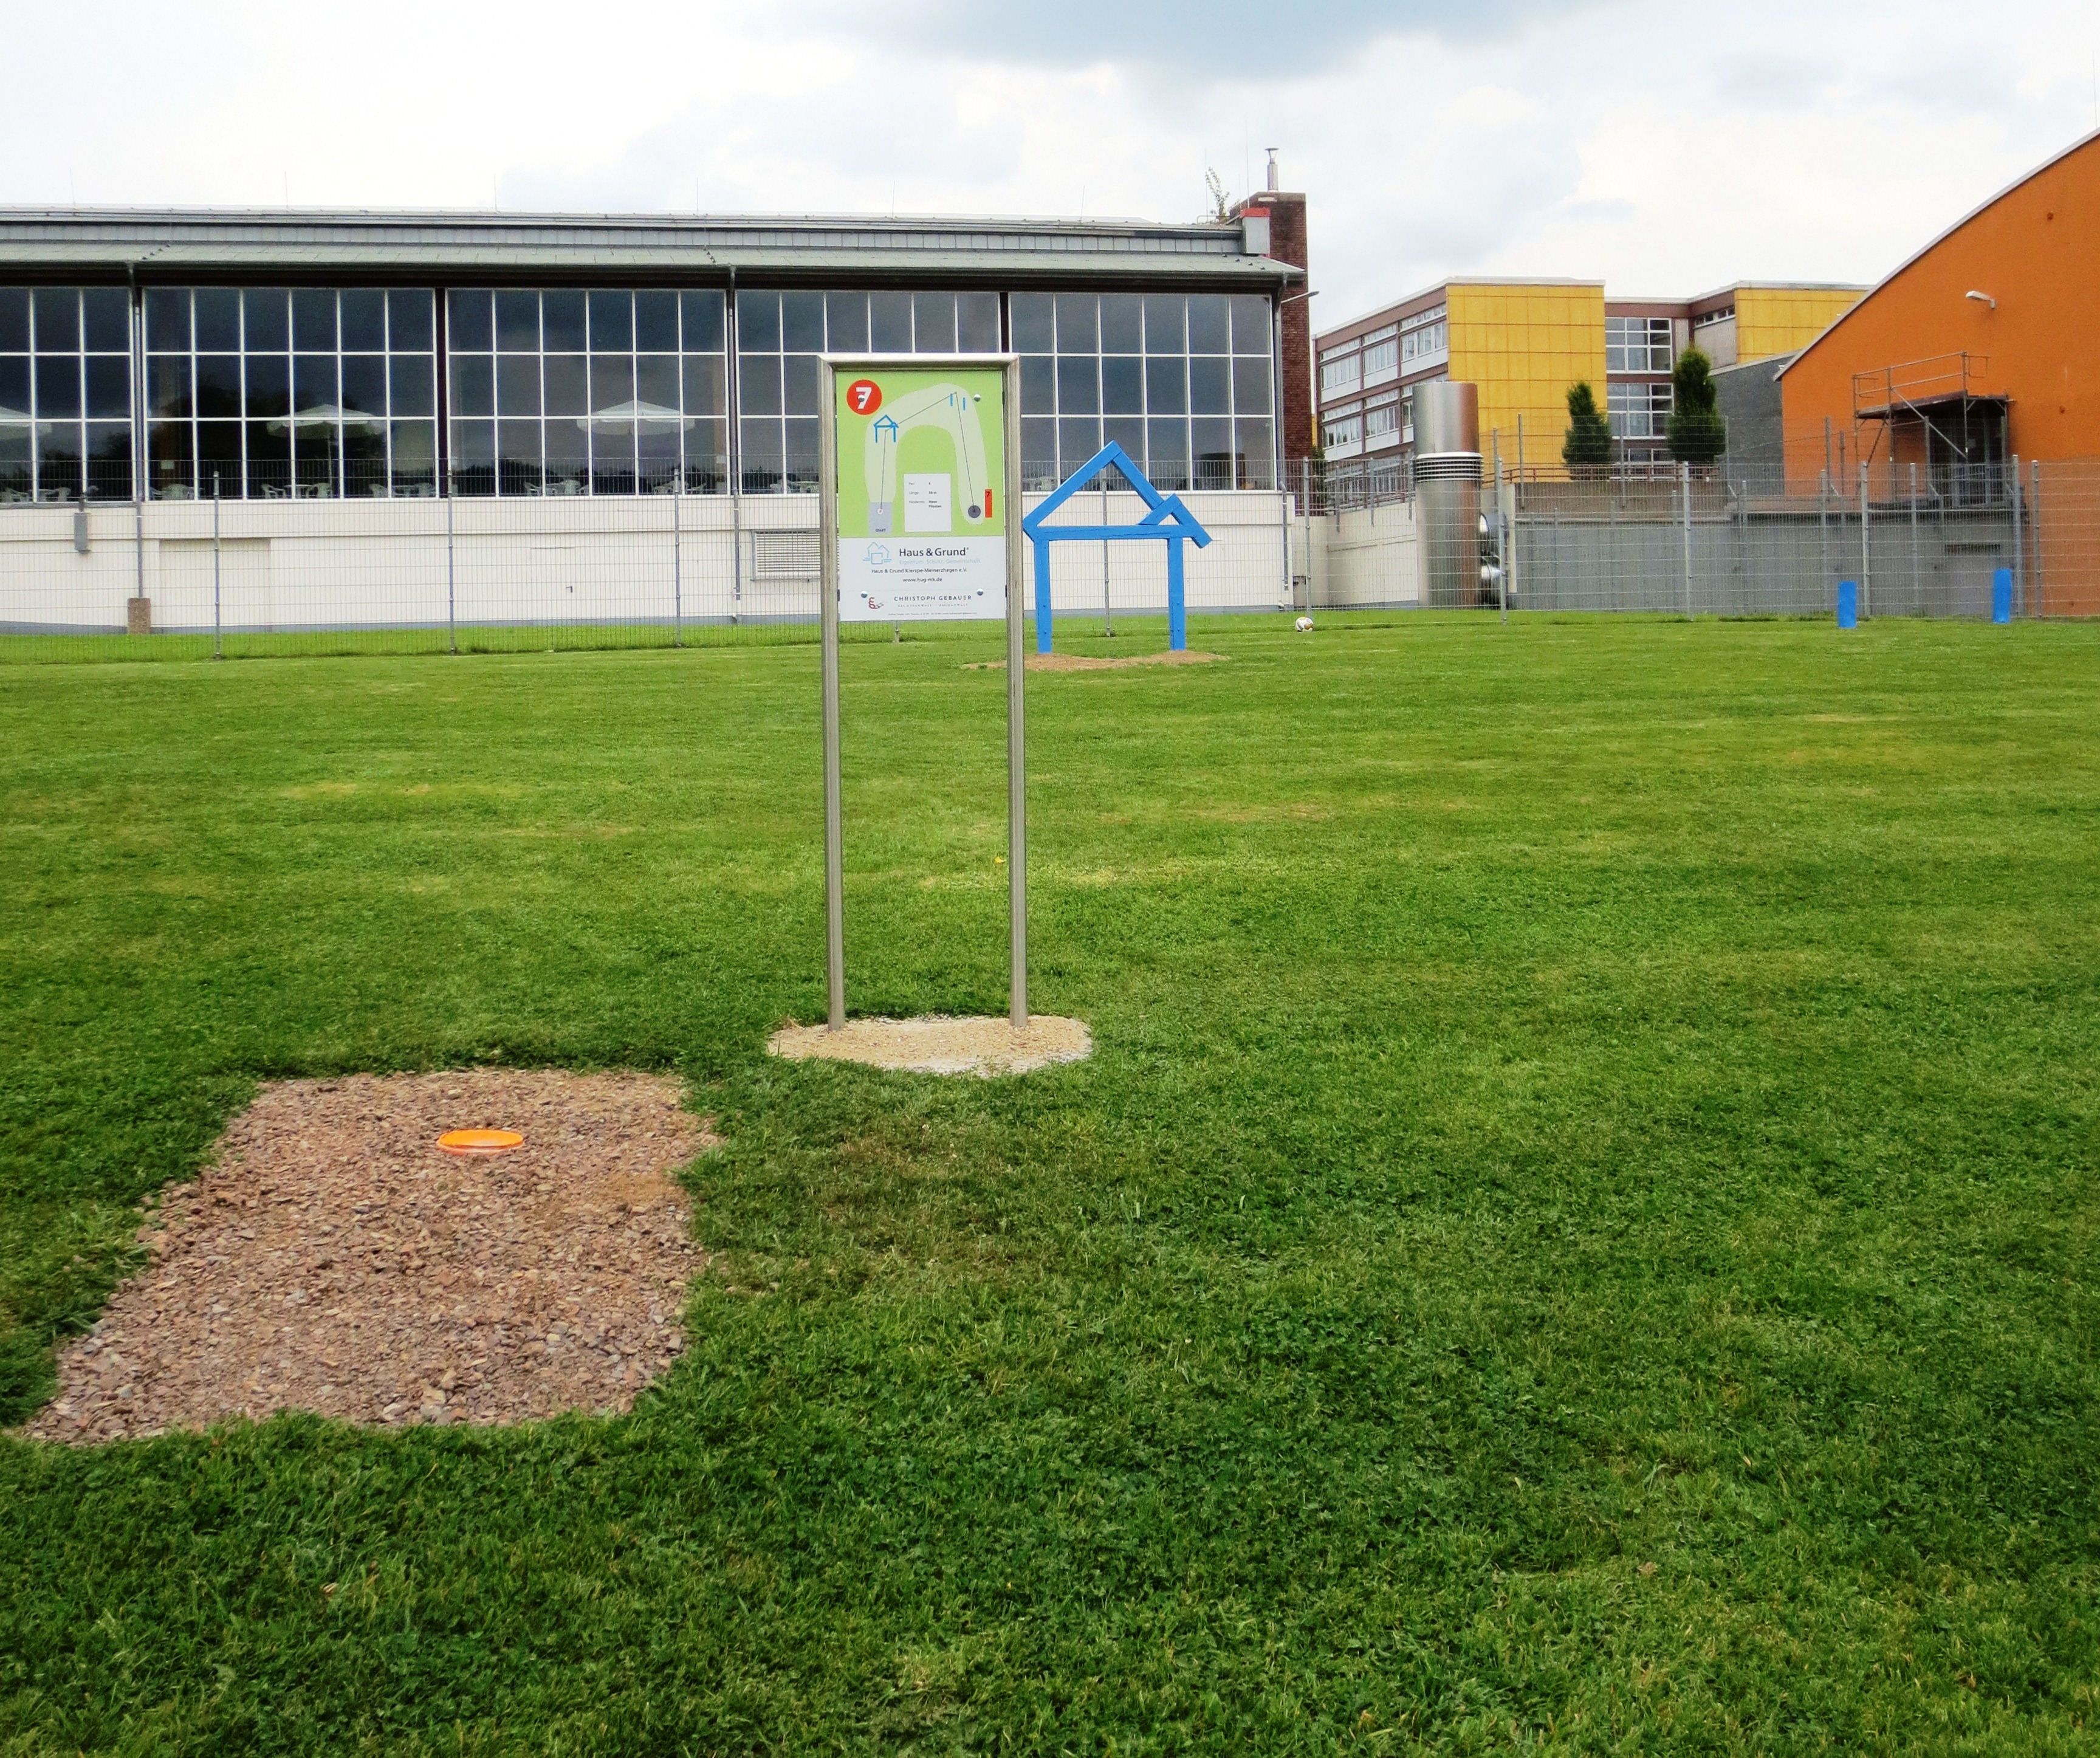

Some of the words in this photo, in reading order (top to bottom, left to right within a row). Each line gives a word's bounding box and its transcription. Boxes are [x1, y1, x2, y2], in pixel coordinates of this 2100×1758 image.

[856, 387, 872, 410] 7
[899, 548, 924, 557] Haus
[925, 548, 933, 557] &
